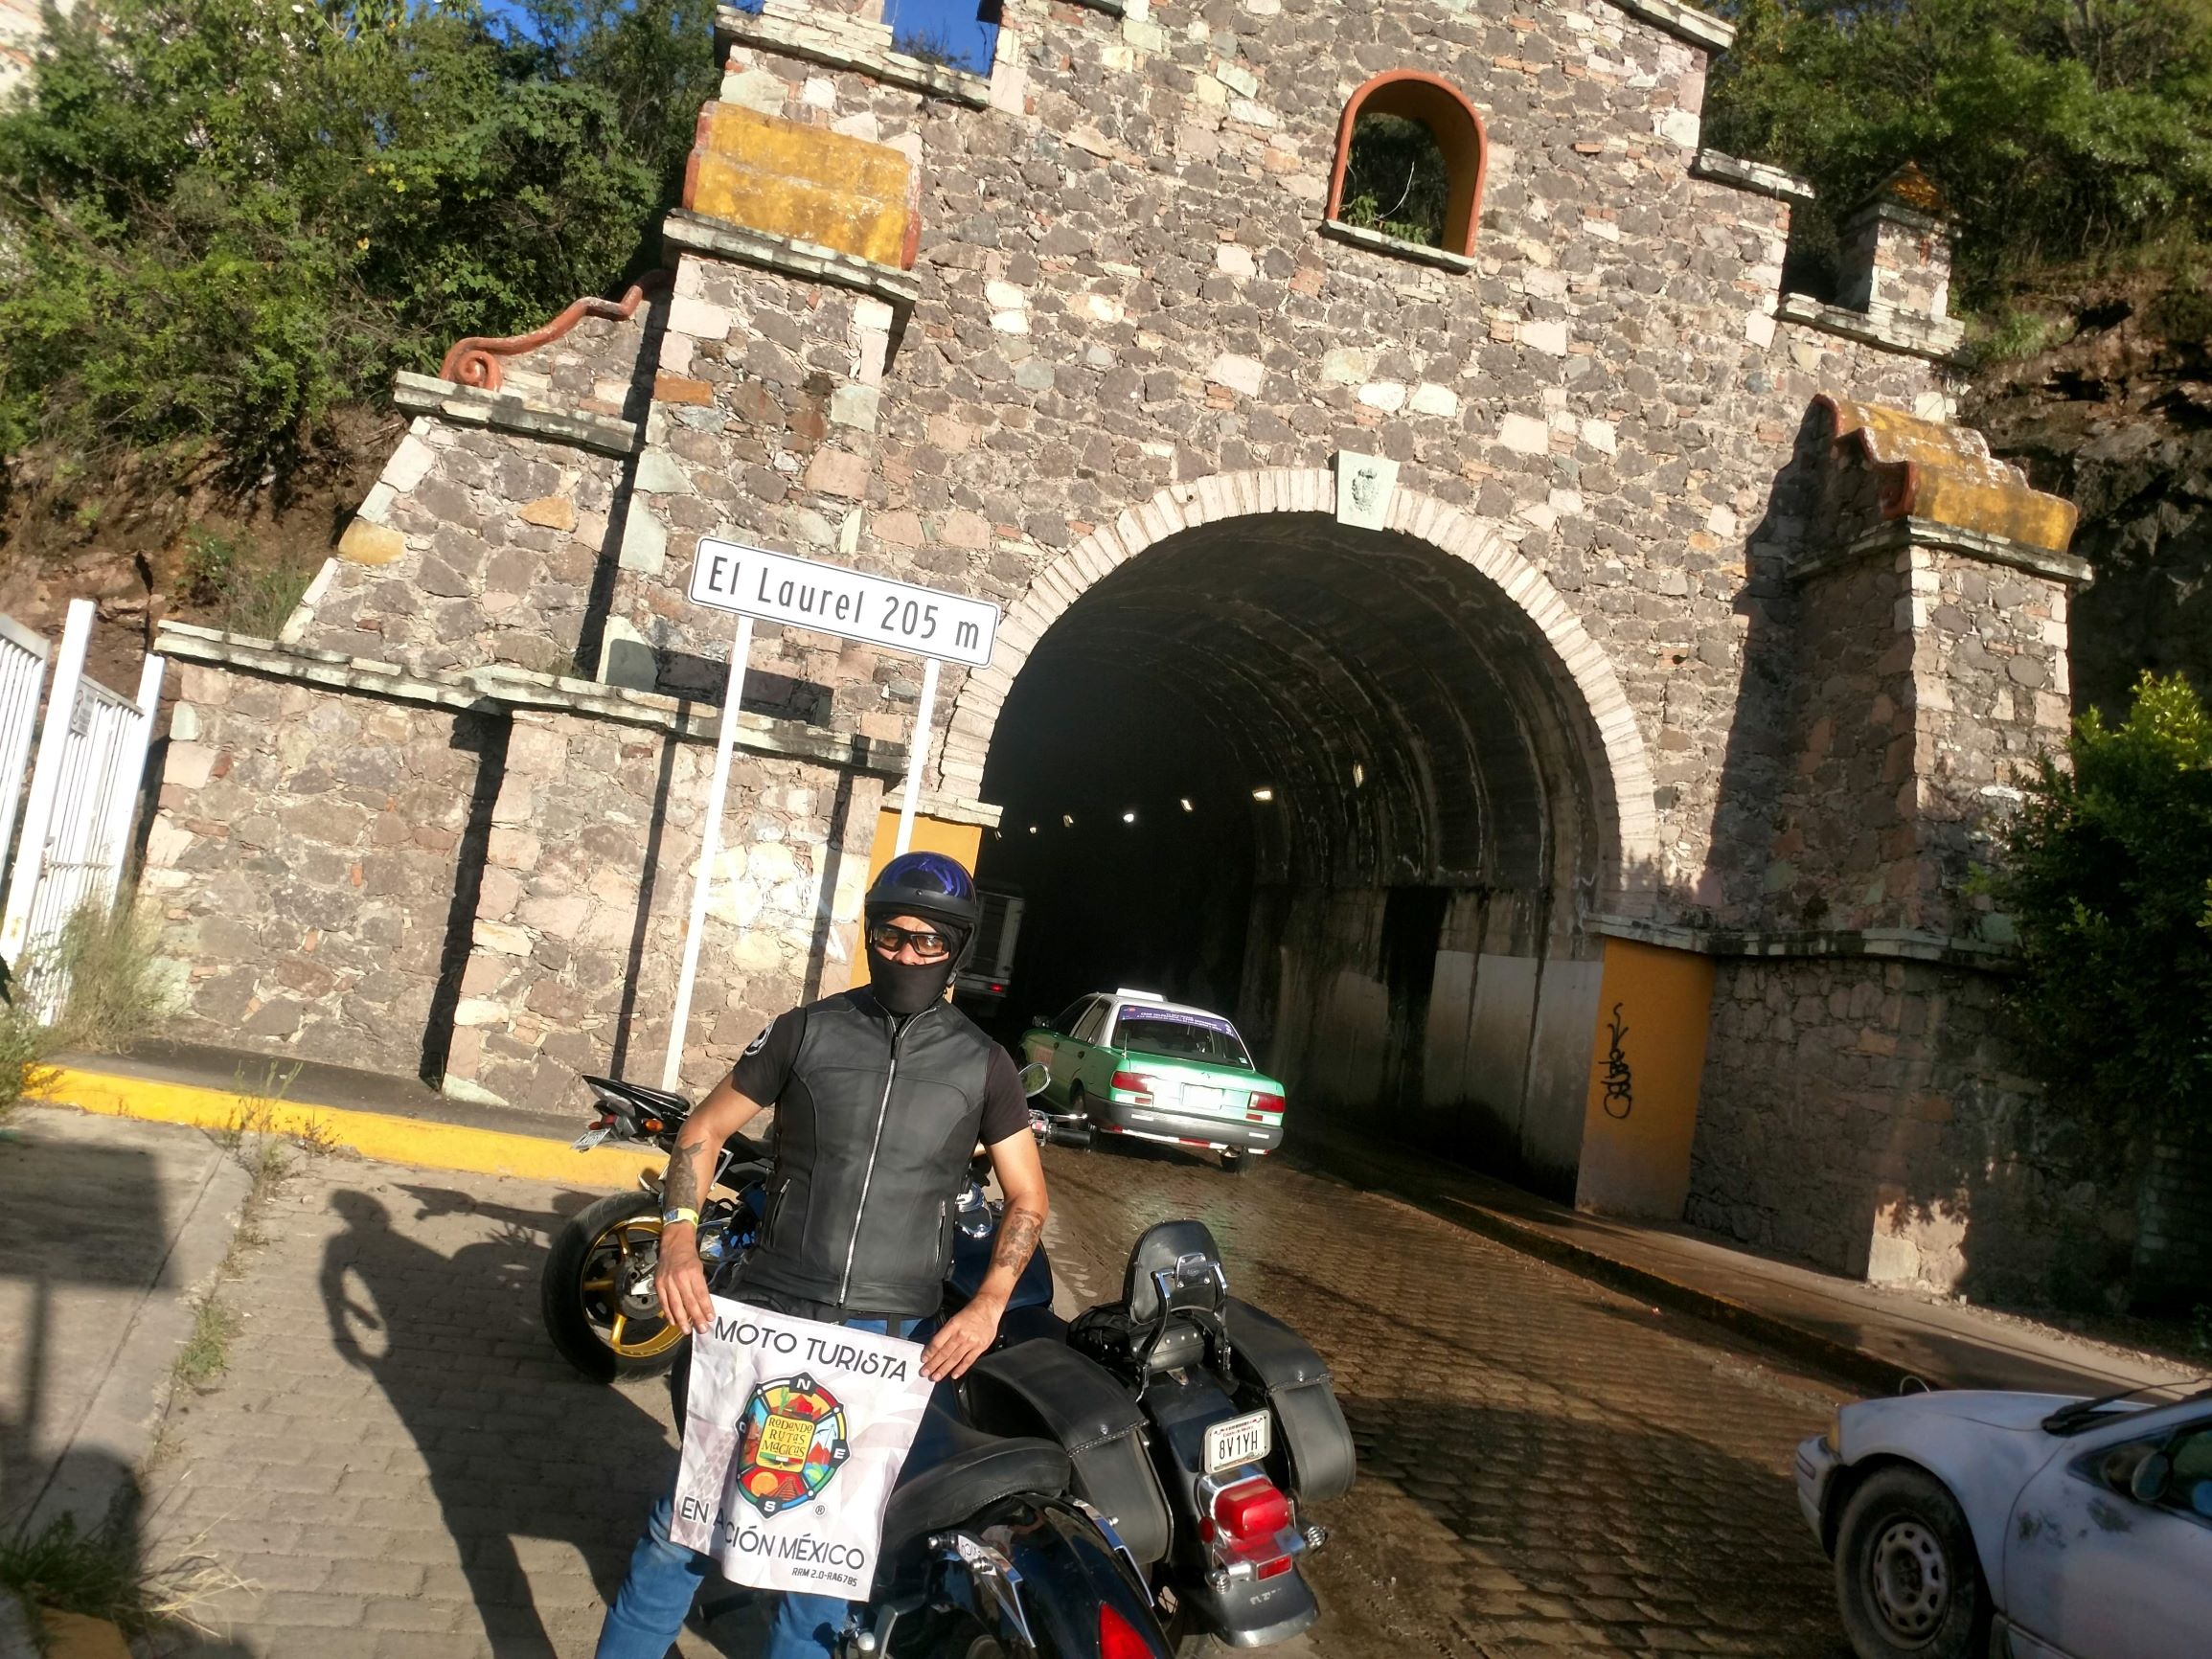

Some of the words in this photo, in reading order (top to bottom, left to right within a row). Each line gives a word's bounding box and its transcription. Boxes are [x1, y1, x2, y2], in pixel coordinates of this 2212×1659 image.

[708, 556, 741, 595] El
[758, 567, 865, 624] Laurel
[881, 596, 940, 640] 205
[955, 620, 980, 650] m
[715, 1316, 797, 1353] MOTO
[807, 1337, 907, 1382] TURISTA
[796, 1378, 811, 1390] N
[833, 1448, 846, 1460] E
[1220, 1430, 1258, 1460] 8V1YH
[764, 1500, 776, 1512] S
[681, 1496, 709, 1523] EN
[778, 1533, 865, 1570] MÉXICO
[792, 1568, 810, 1579] RRM
